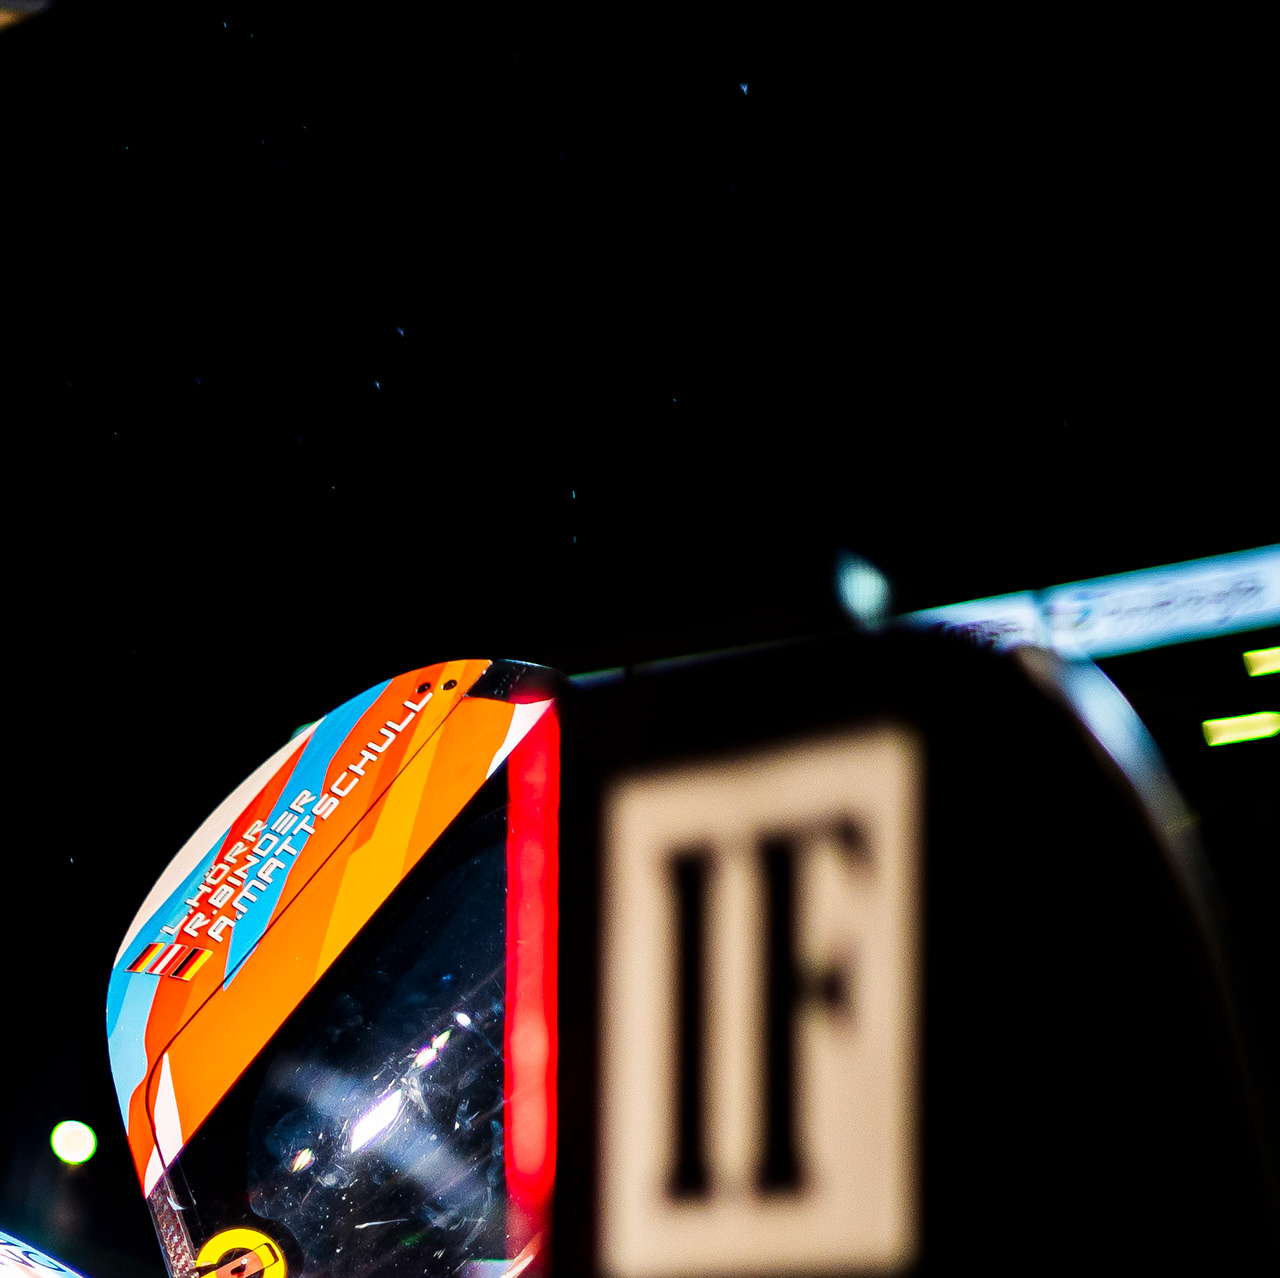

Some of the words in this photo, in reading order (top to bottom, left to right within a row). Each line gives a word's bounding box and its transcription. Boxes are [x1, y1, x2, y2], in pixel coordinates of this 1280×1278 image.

[161, 819, 268, 935] L.HÖRR
[183, 789, 316, 938] R.BINDER
[207, 692, 434, 942] A.MATTSCHULL
